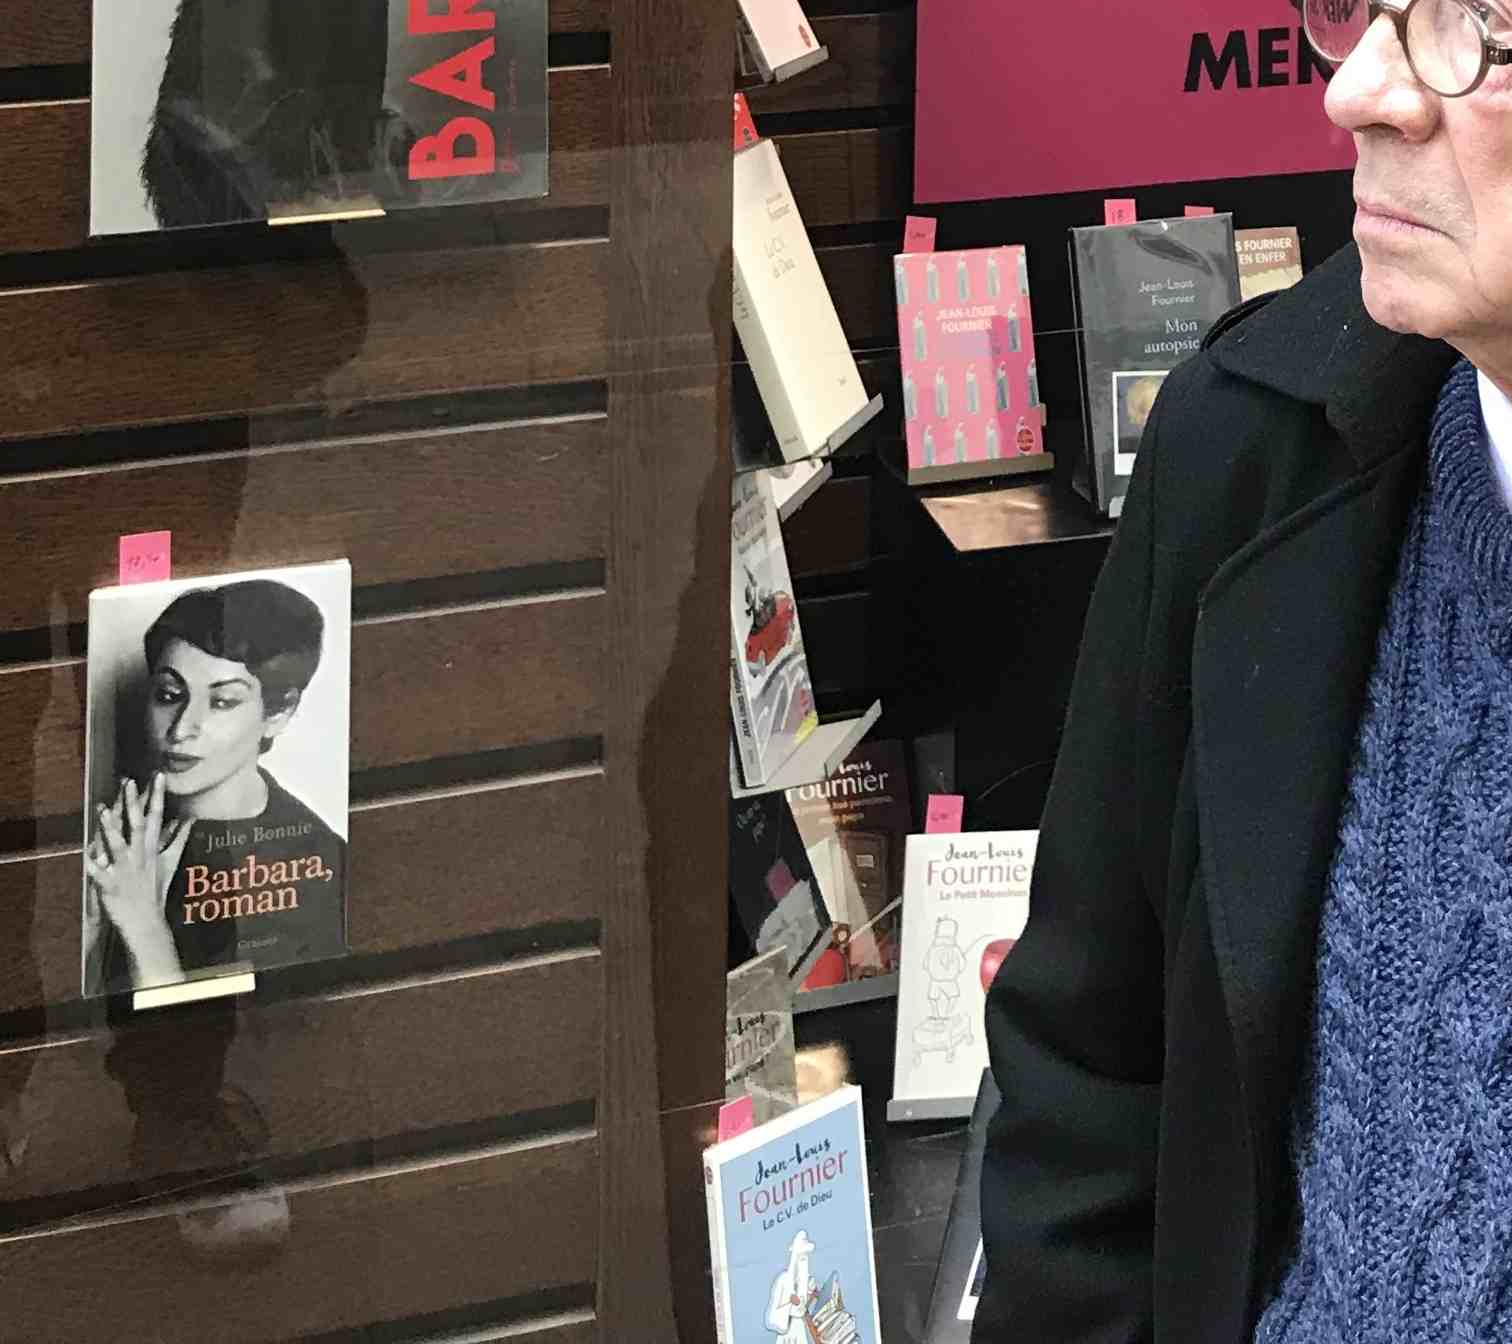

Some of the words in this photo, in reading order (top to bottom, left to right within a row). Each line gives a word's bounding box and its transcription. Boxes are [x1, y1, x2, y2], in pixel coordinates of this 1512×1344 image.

[1244, 238, 1292, 251] FOURNIER
[1255, 251, 1287, 263] ENFER
[1151, 294, 1195, 306] Fournier
[1166, 319, 1198, 334] Mon
[205, 829, 247, 853] Julie
[253, 822, 313, 843] Bonnie
[945, 841, 1023, 862] Jean-Louis
[183, 854, 333, 898] Barbara,
[927, 858, 1028, 886] Fournie
[183, 886, 299, 925] roman
[755, 1138, 831, 1185] Jean-Louis
[738, 1150, 847, 1224] Fournier
[762, 1216, 775, 1231] Le
[811, 1190, 833, 1208] Dieu
